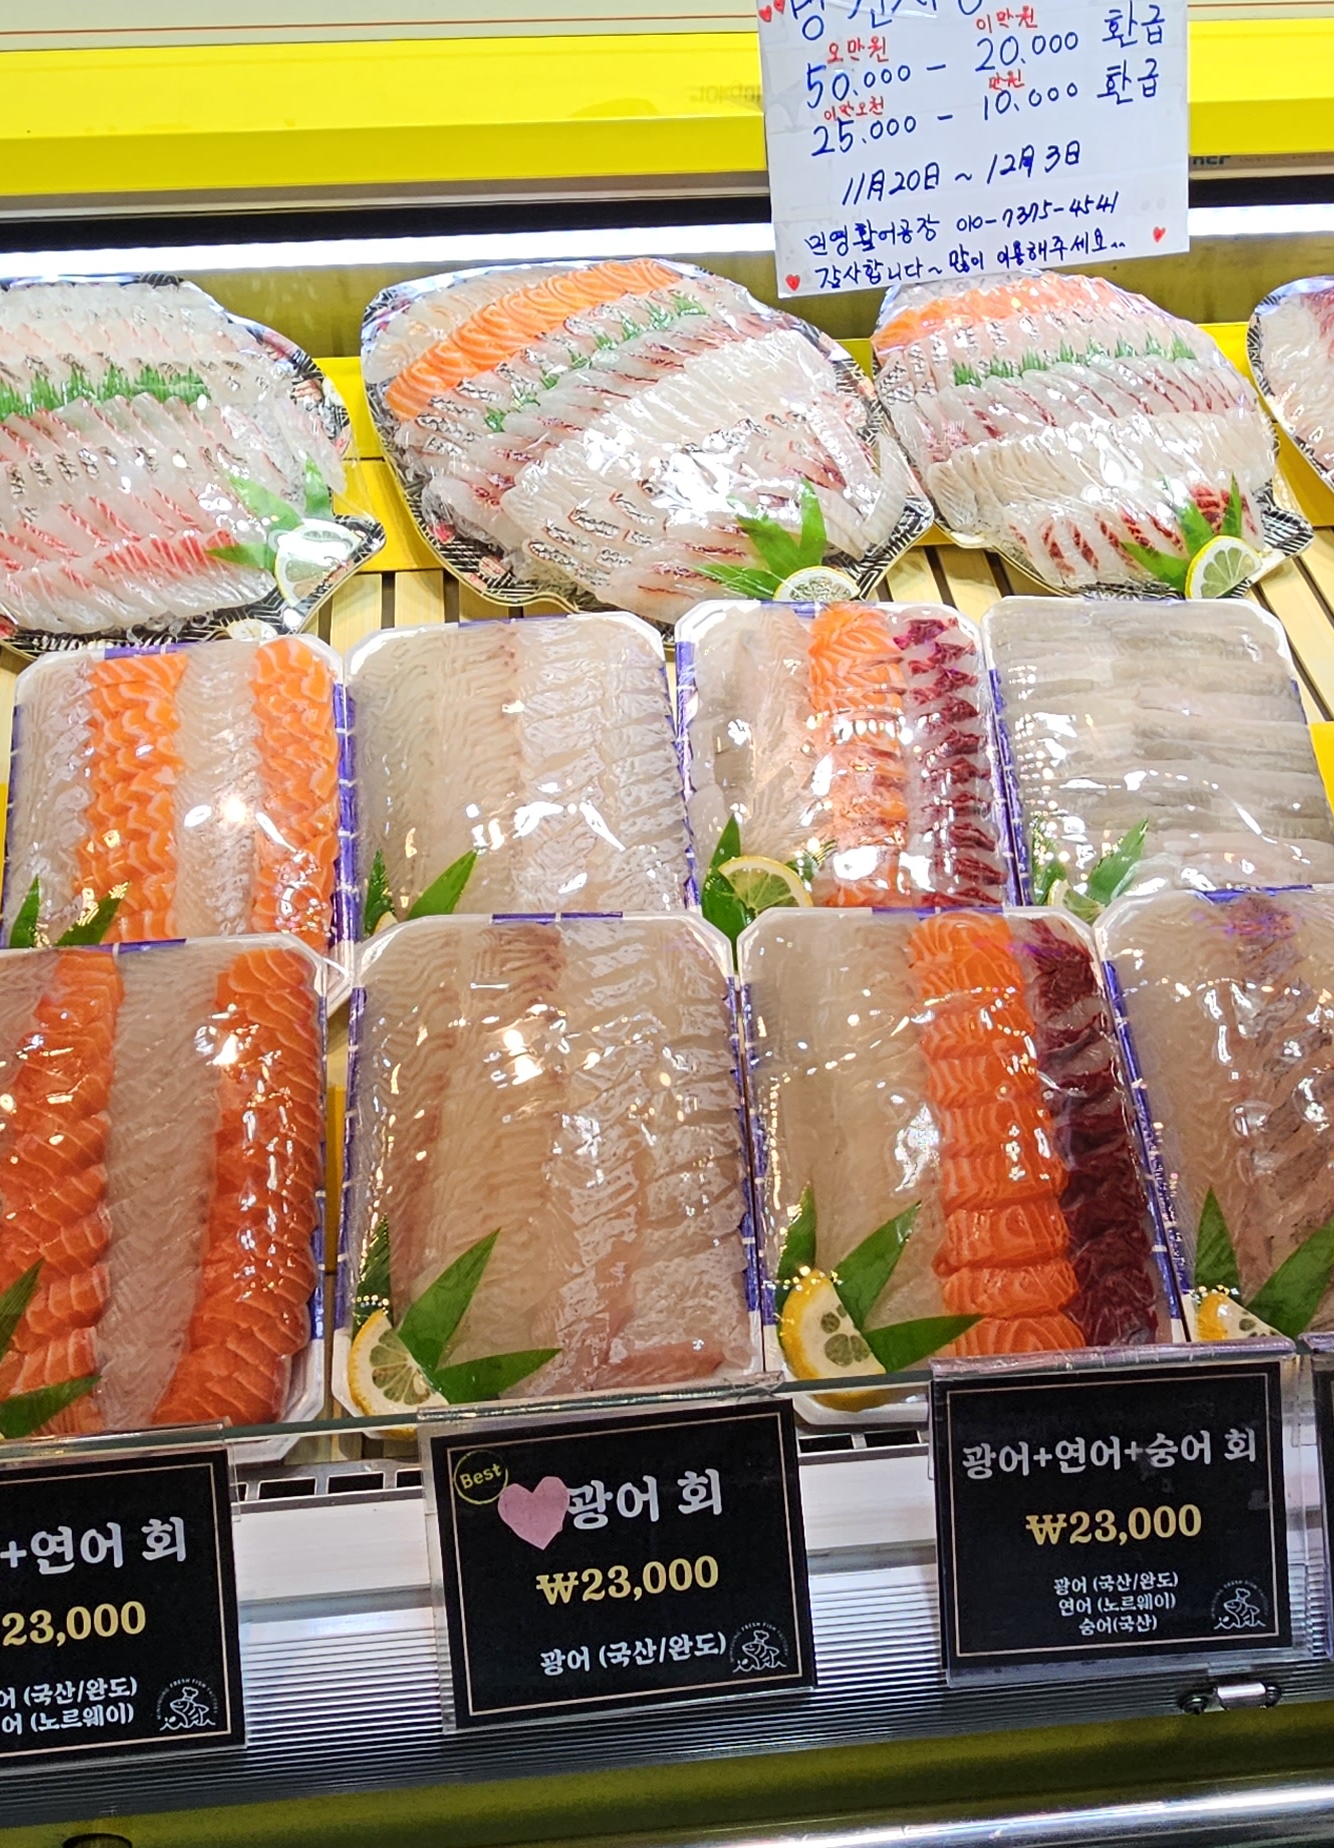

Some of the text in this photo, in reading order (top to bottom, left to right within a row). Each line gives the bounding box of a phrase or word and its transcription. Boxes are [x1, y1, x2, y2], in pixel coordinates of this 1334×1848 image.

[1101, 0, 1166, 48] 환급
[1096, 58, 1160, 105] 환급
[956, 191, 1120, 235] 010-7375-4541
[948, 244, 985, 274] 많이
[962, 1427, 1257, 1480] 광어+연어+숭어 회
[460, 1464, 502, 1489] Best
[567, 1468, 723, 1531] 광어 회
[141, 1516, 187, 1562] 회
[1025, 1504, 1202, 1545] ₩23,000
[536, 1556, 719, 1605] ₩23,000
[1053, 1571, 1179, 1596] 광어 (국산/완도)
[1058, 1591, 1177, 1617] 연어 (노르웨이)
[1078, 1615, 1158, 1637] 숭어(국산)
[540, 1646, 591, 1676] 광어
[598, 1632, 727, 1669] (국산/완도)
[23, 1676, 138, 1706] (국산/완도)
[30, 1703, 135, 1733] (노르웨이)
